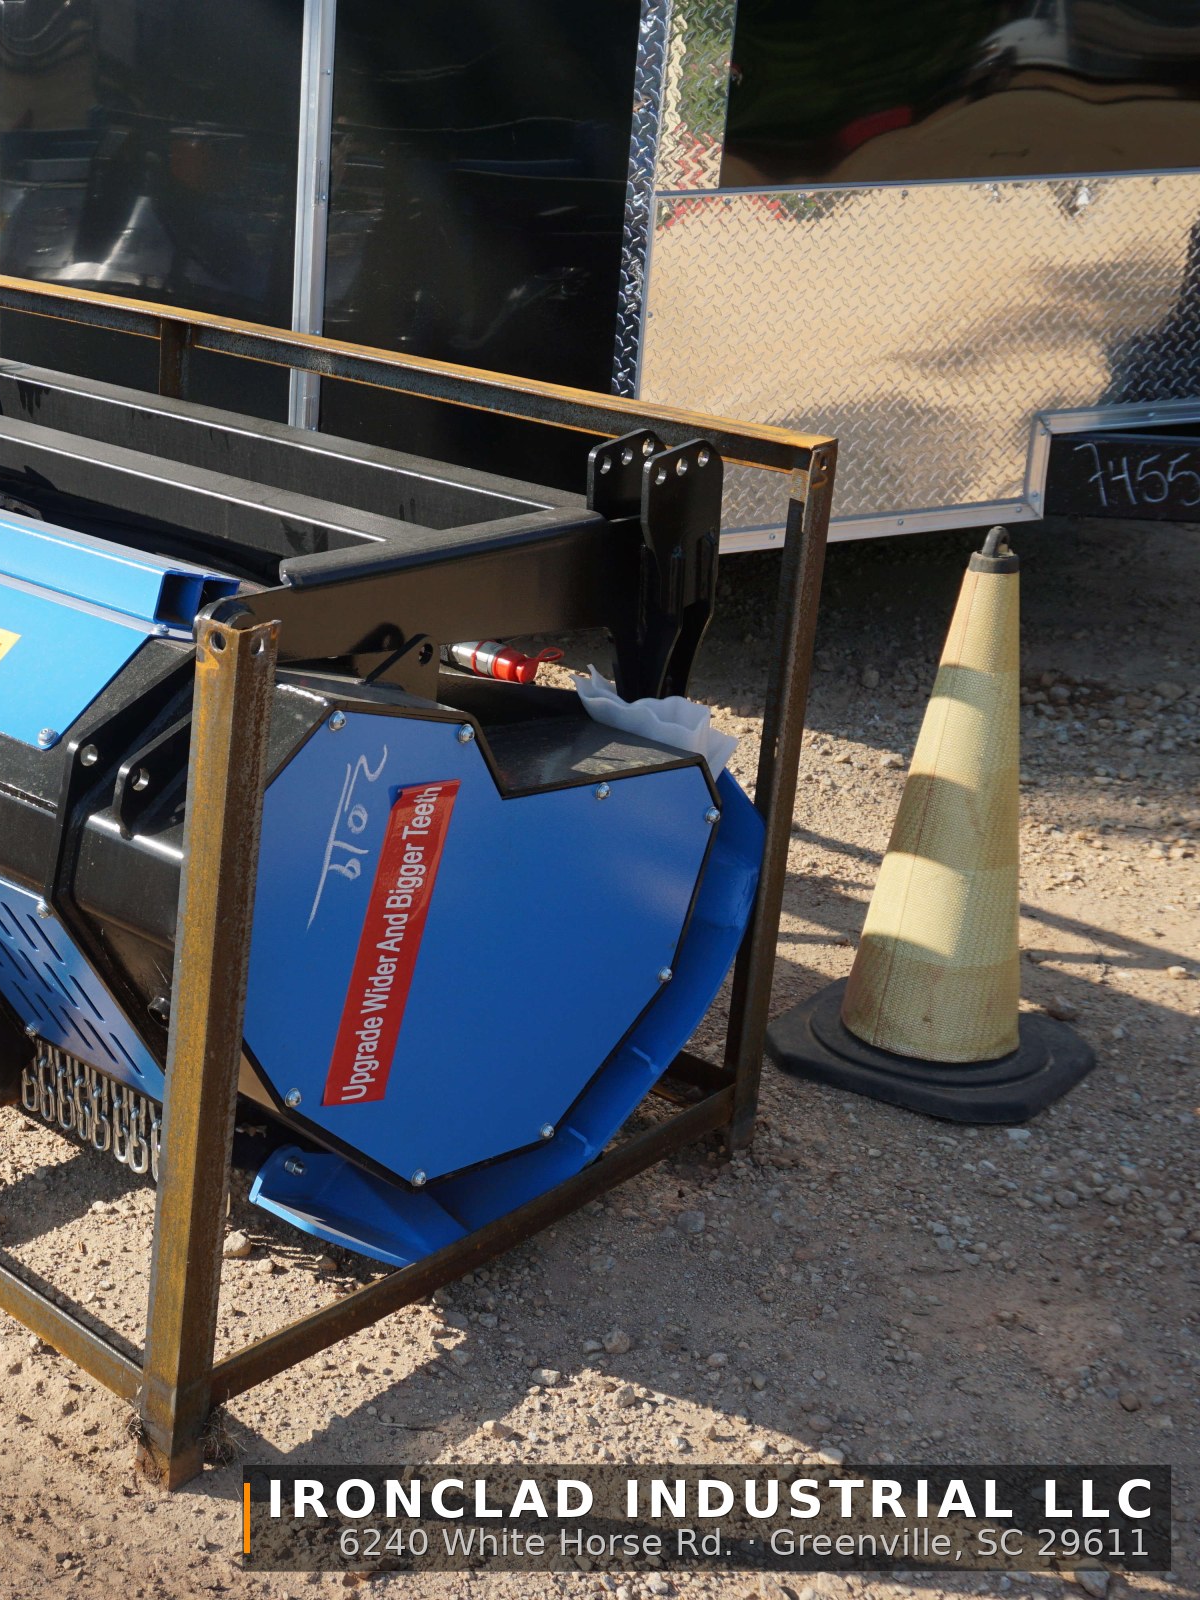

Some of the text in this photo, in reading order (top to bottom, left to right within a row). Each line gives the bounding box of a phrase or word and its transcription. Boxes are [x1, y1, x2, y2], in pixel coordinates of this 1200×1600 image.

[341, 786, 443, 1101] Upgrade Wider And Bigger Teeth
